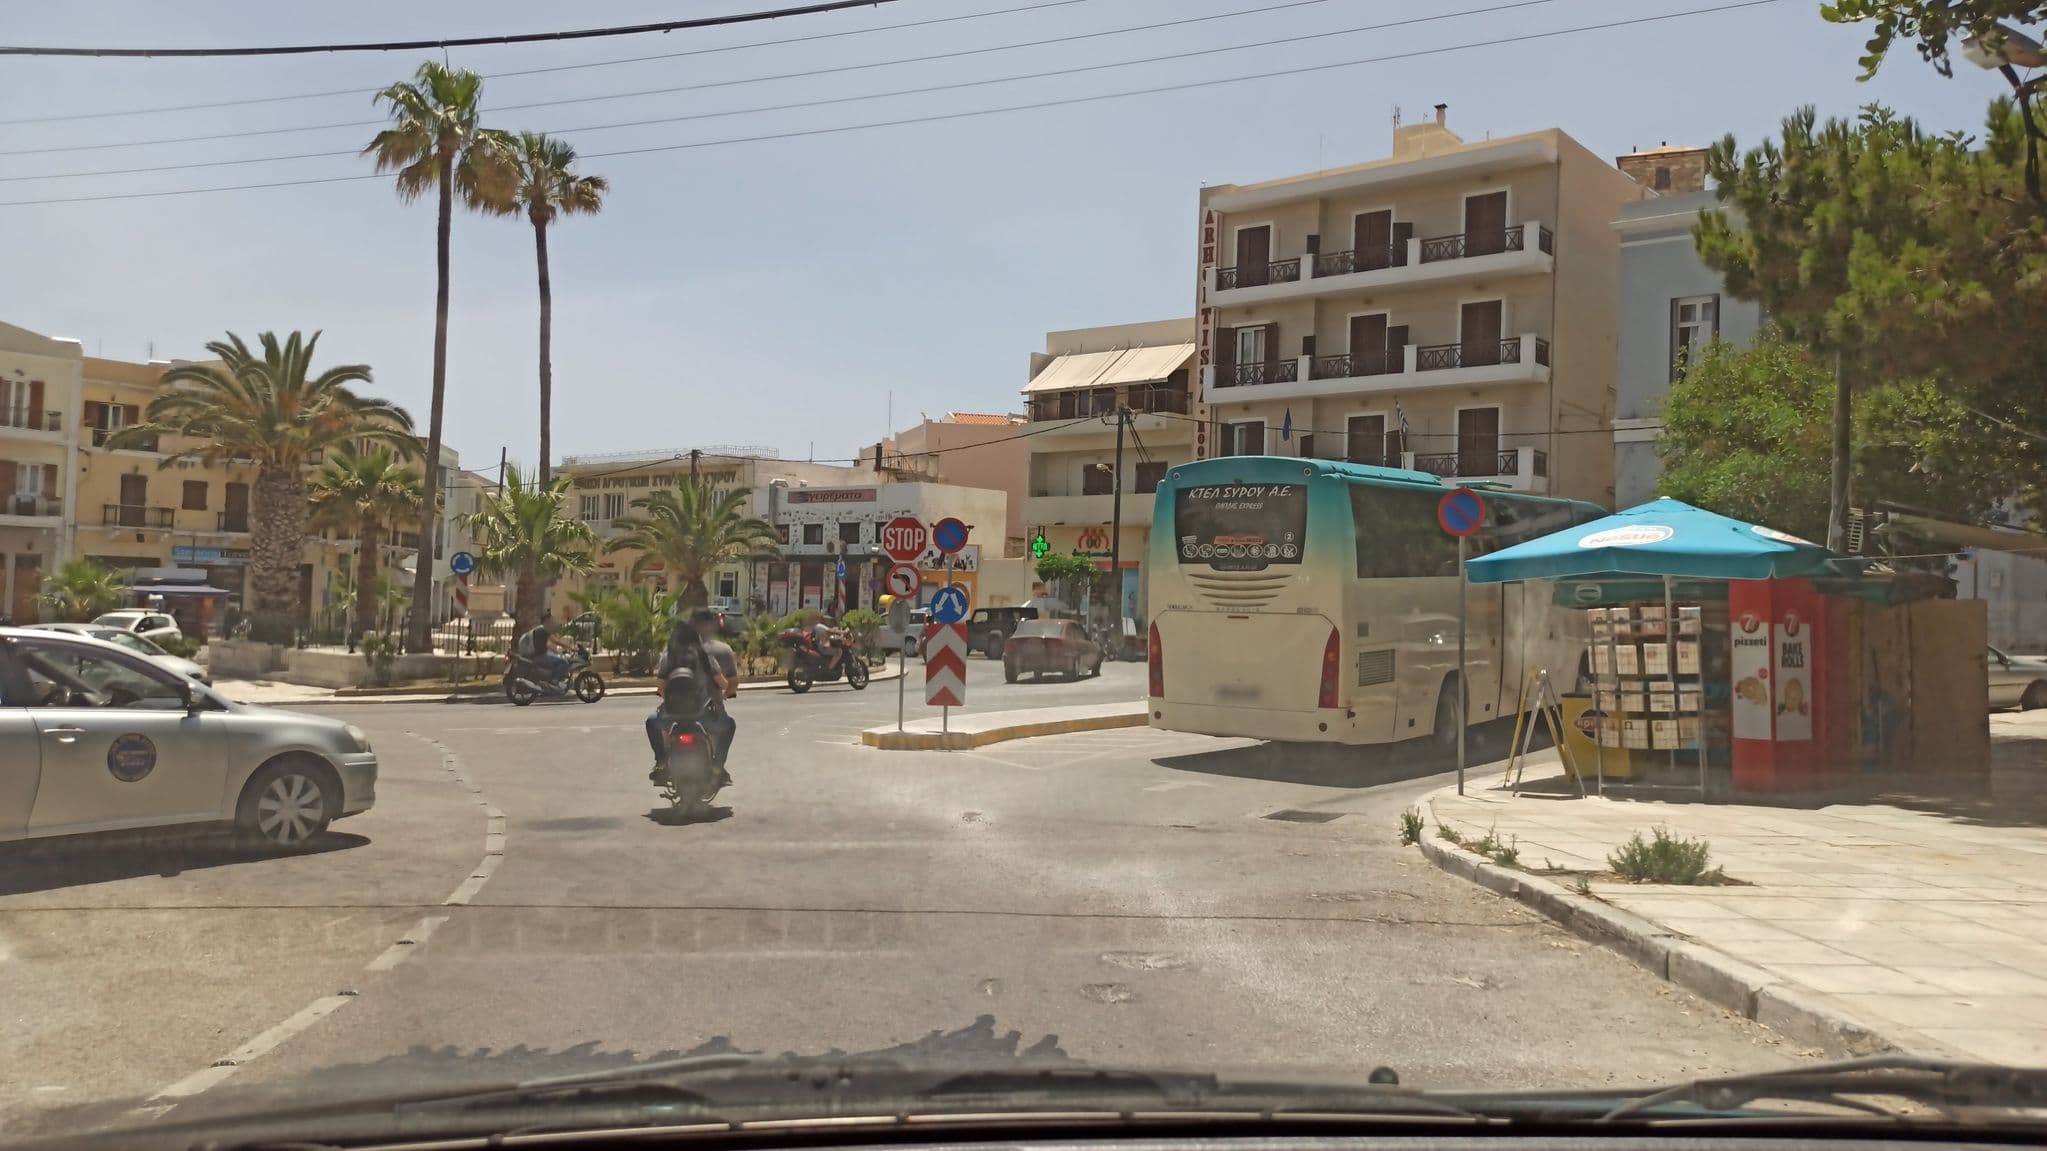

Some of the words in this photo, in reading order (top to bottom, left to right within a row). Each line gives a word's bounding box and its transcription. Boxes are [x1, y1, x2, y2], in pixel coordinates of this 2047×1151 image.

[1188, 487, 1221, 499] ΚΤΕΛ
[1223, 486, 1265, 498] ΣΥΡΟΥ
[885, 527, 925, 551] STOP
